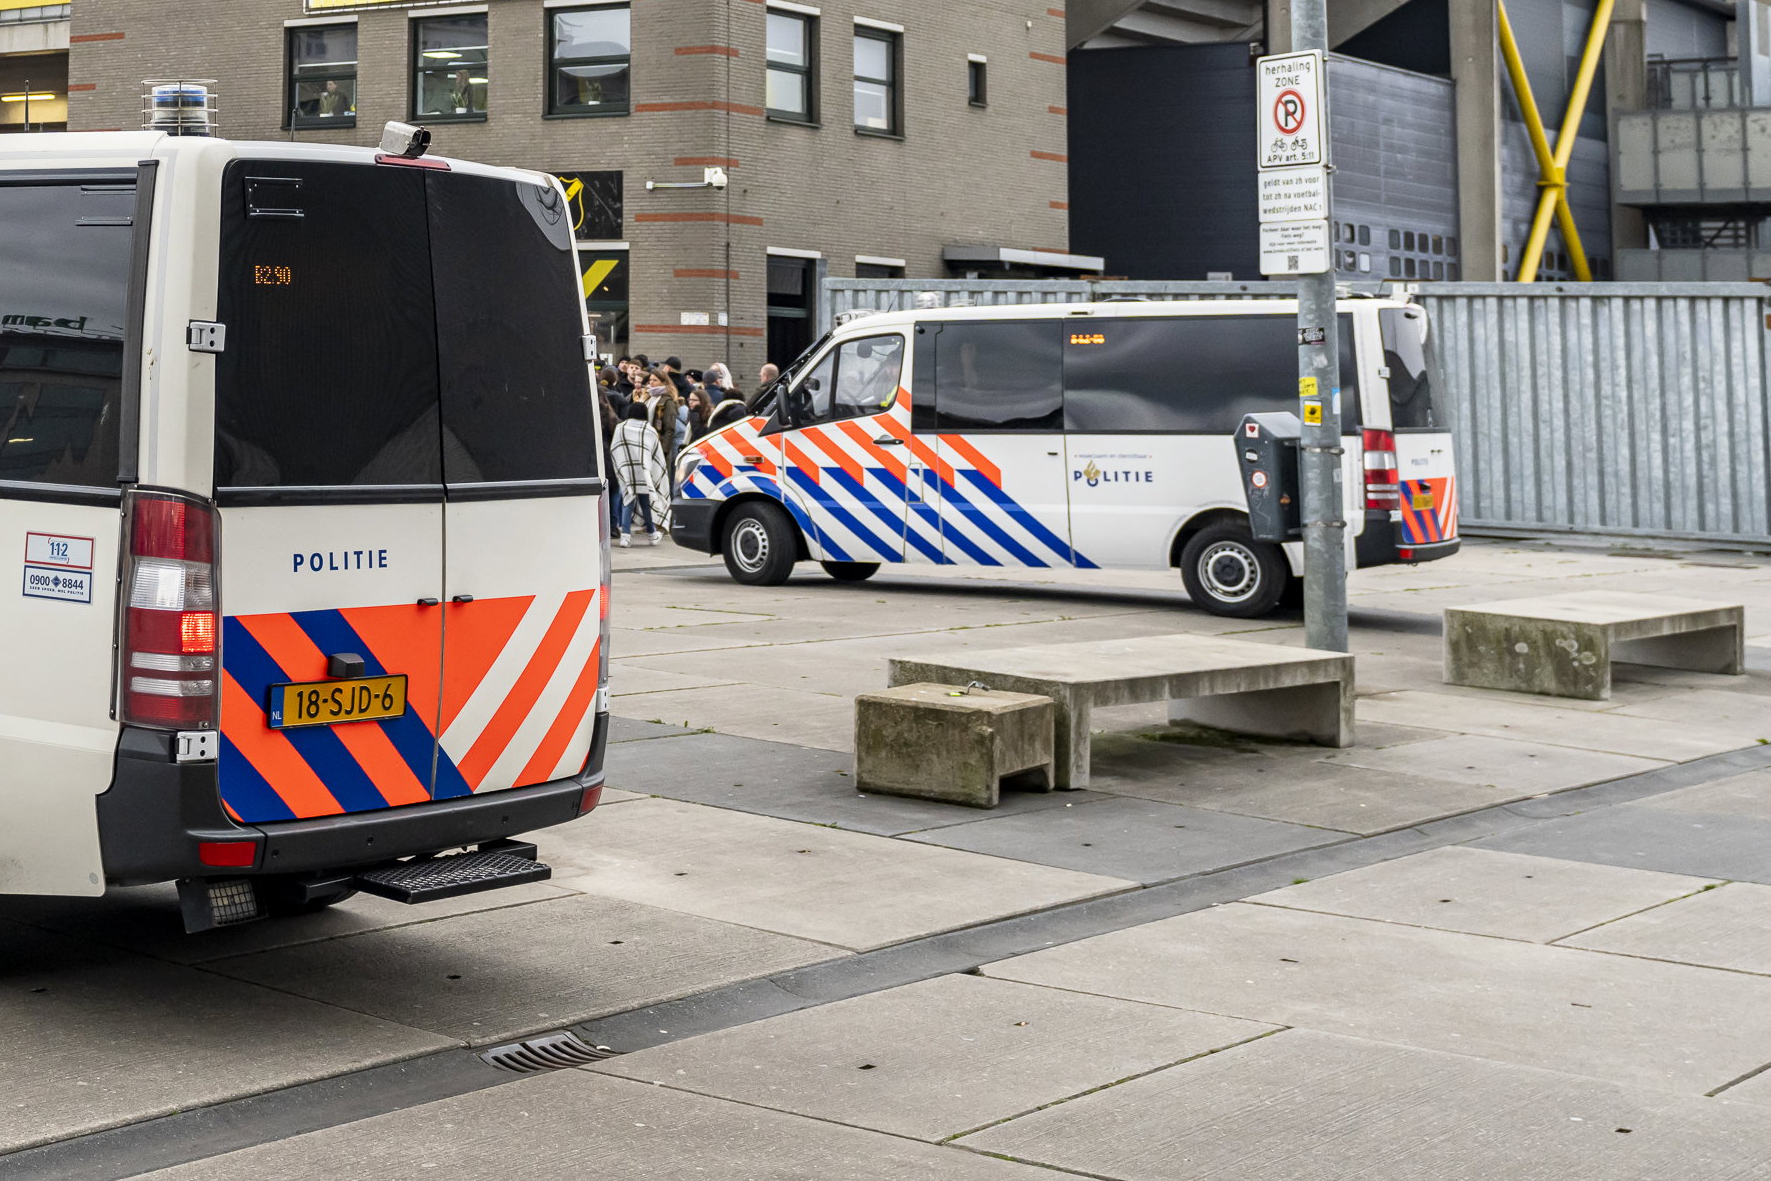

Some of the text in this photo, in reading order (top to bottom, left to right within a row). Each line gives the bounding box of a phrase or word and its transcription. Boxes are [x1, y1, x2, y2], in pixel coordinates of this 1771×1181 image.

[1265, 61, 1311, 76] herhaling
[1275, 75, 1301, 88] ZONE
[1267, 154, 1283, 163] APV
[1282, 178, 1293, 186] van
[1304, 203, 1317, 211] NAC
[1074, 470, 1153, 488] POLITIE
[293, 549, 388, 572] POLITIE
[29, 574, 84, 590] 0900 8844
[296, 682, 394, 719] 18-SJD-6
[272, 711, 282, 721] NL
